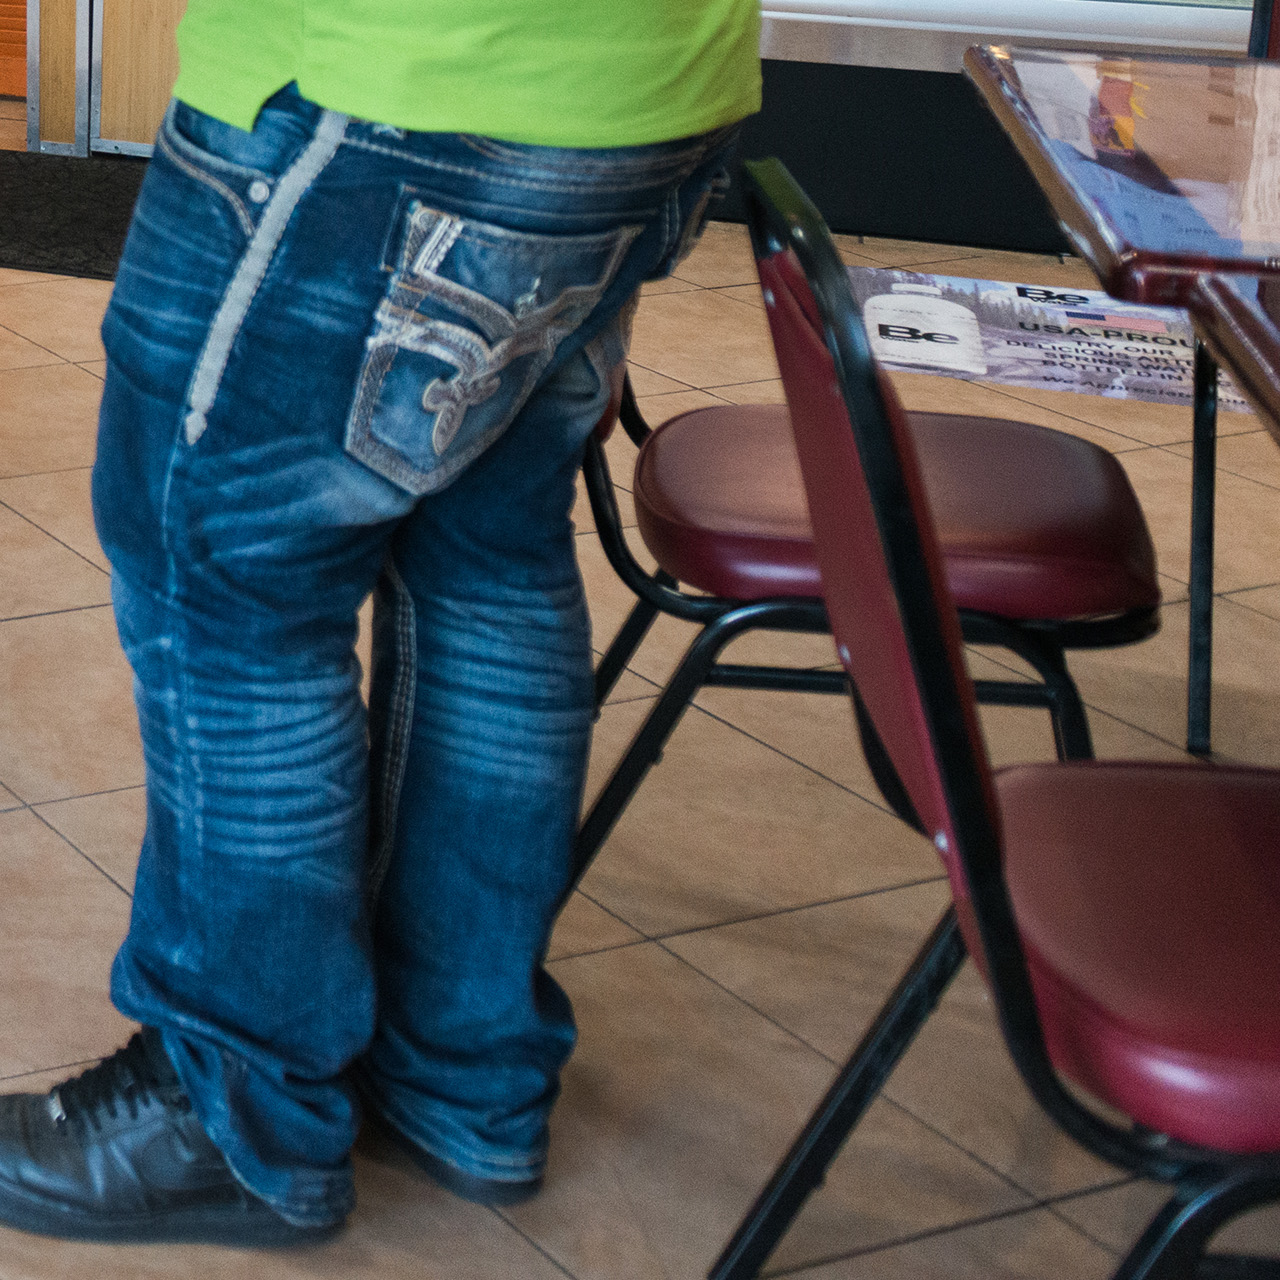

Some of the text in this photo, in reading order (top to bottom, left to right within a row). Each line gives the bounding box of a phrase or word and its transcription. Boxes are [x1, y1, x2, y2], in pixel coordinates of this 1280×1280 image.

[1016, 286, 1090, 304] Be
[878, 324, 960, 345] Be
[1018, 321, 1196, 349] USA-PROU
[1006, 340, 1130, 360] DELICIOUS
[1074, 340, 1175, 356] TRY OUR
[1044, 352, 1132, 368] SPRING
[1042, 360, 1184, 382] BOTTLED IN
[1042, 376, 1195, 398] We Appreciat
